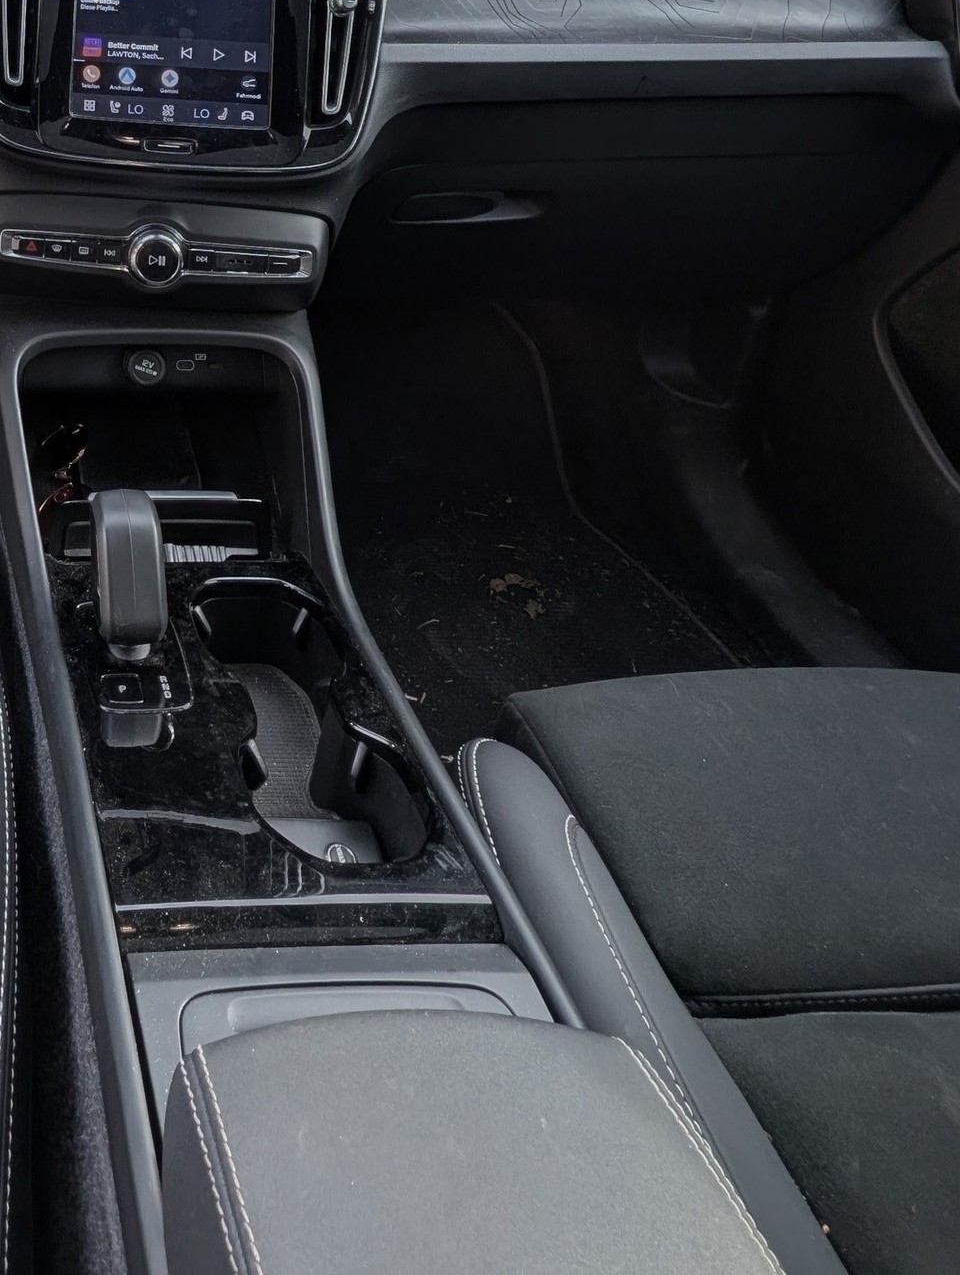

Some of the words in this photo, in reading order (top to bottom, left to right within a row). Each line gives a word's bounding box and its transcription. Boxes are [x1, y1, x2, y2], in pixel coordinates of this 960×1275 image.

[107, 41, 130, 50] Better
[130, 43, 159, 52] Commit
[107, 50, 141, 60] LAWTON,
[81, 82, 100, 90] Telefon
[109, 84, 130, 92] Android
[159, 87, 179, 95] Gemini
[236, 92, 262, 100] Fahrmodi
[127, 103, 144, 115] LO
[193, 108, 210, 119] LO
[118, 685, 127, 693] P
